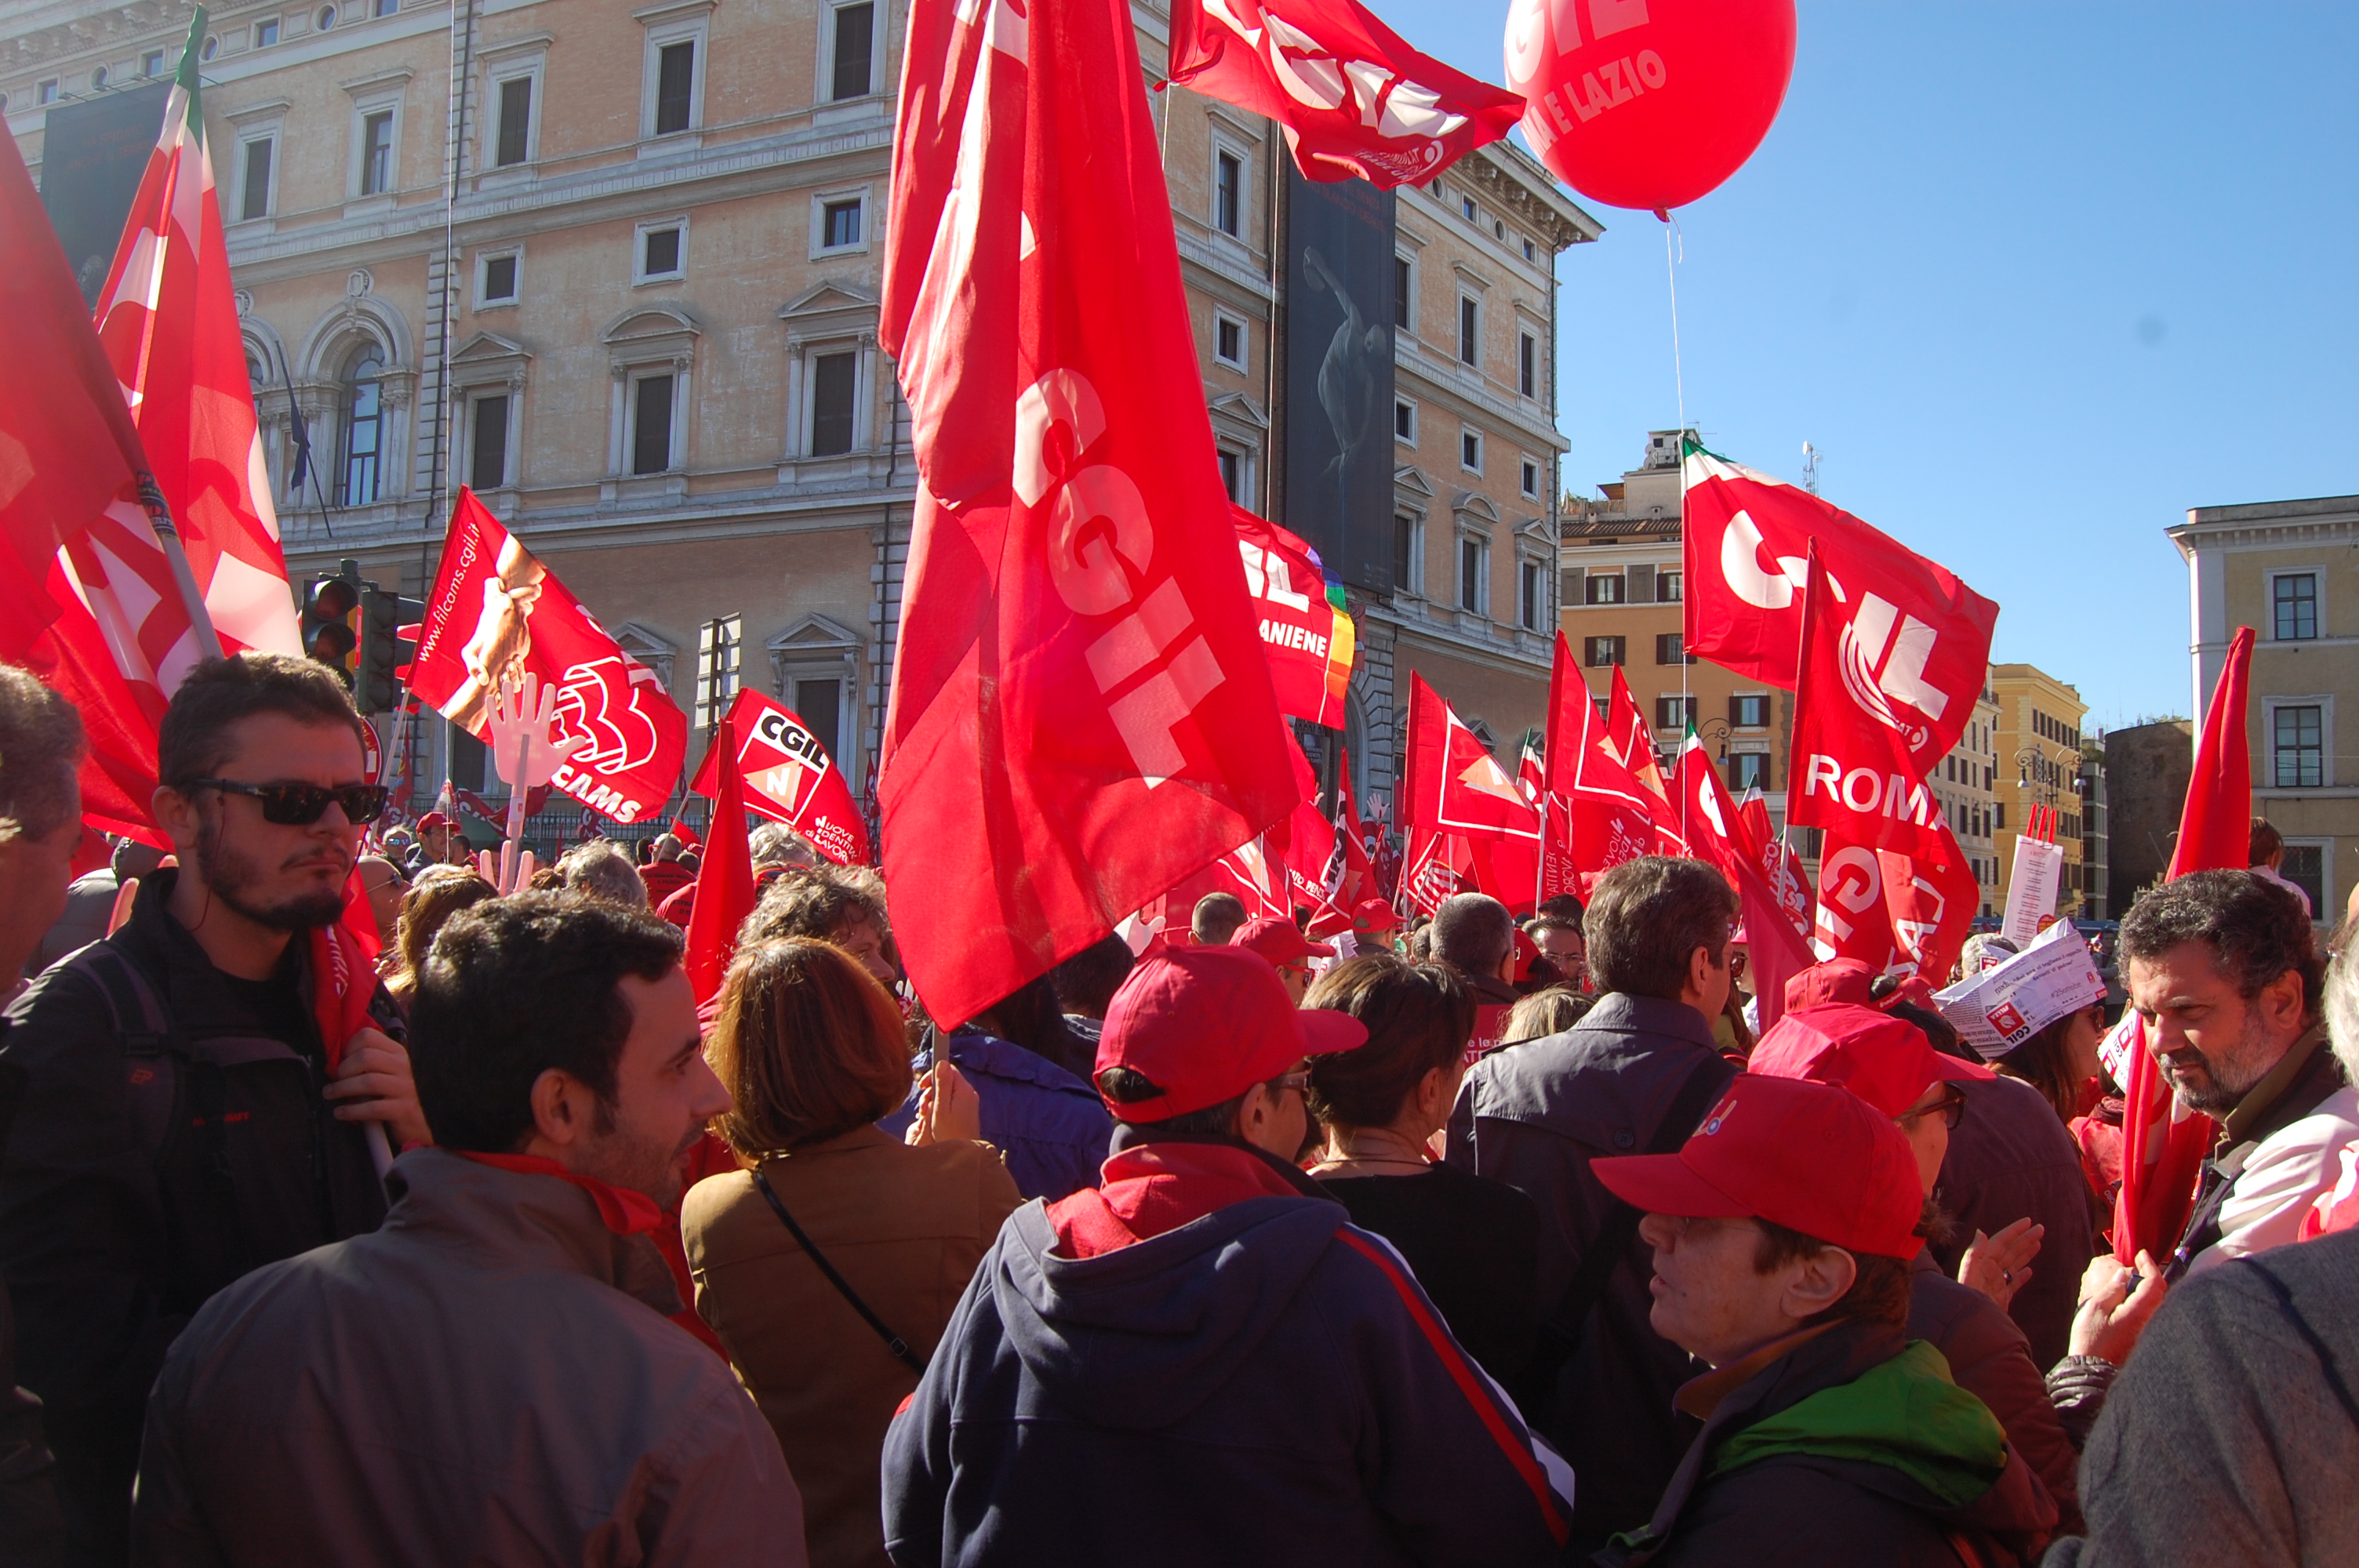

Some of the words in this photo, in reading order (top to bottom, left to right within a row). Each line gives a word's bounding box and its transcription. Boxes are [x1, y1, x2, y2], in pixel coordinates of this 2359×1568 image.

[1544, 91, 1573, 135] E
[1564, 49, 1667, 123] LAZIO
[418, 521, 482, 663] www.filcams.cgil.it
[1012, 368, 1227, 789] CGIL
[1259, 619, 1328, 658] ANIENE
[761, 715, 825, 770] CGIL
[814, 815, 855, 843] NUOVE
[2006, 1025, 2031, 1044] CGIL
